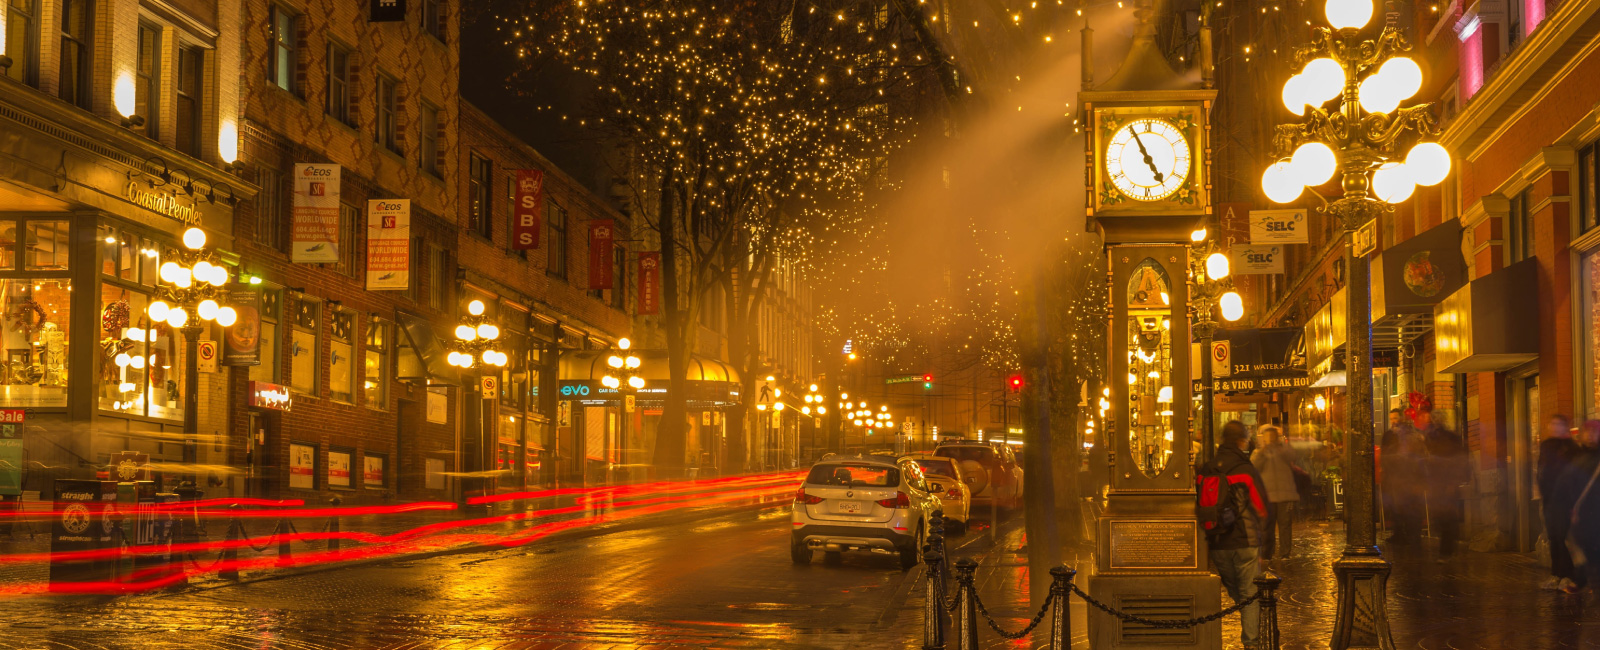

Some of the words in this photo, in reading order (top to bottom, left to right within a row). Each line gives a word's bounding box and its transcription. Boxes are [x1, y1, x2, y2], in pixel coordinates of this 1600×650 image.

[304, 166, 331, 176] GEOS
[129, 181, 167, 215] Coastal
[168, 196, 202, 227] Peoples
[376, 202, 402, 211] GEOS
[295, 215, 338, 225] WORLDWIDE
[519, 195, 535, 245] SBS
[1266, 221, 1295, 232] SELC
[369, 246, 408, 254] WORLDWIDE
[1247, 254, 1273, 263] SELC
[1234, 364, 1250, 375] 321
[561, 384, 590, 396] evo
[1222, 381, 1230, 391] &
[1231, 380, 1254, 389] VINO
[1261, 378, 1292, 389] STEAK
[0, 410, 23, 422] Sale
[61, 492, 95, 501] straight
